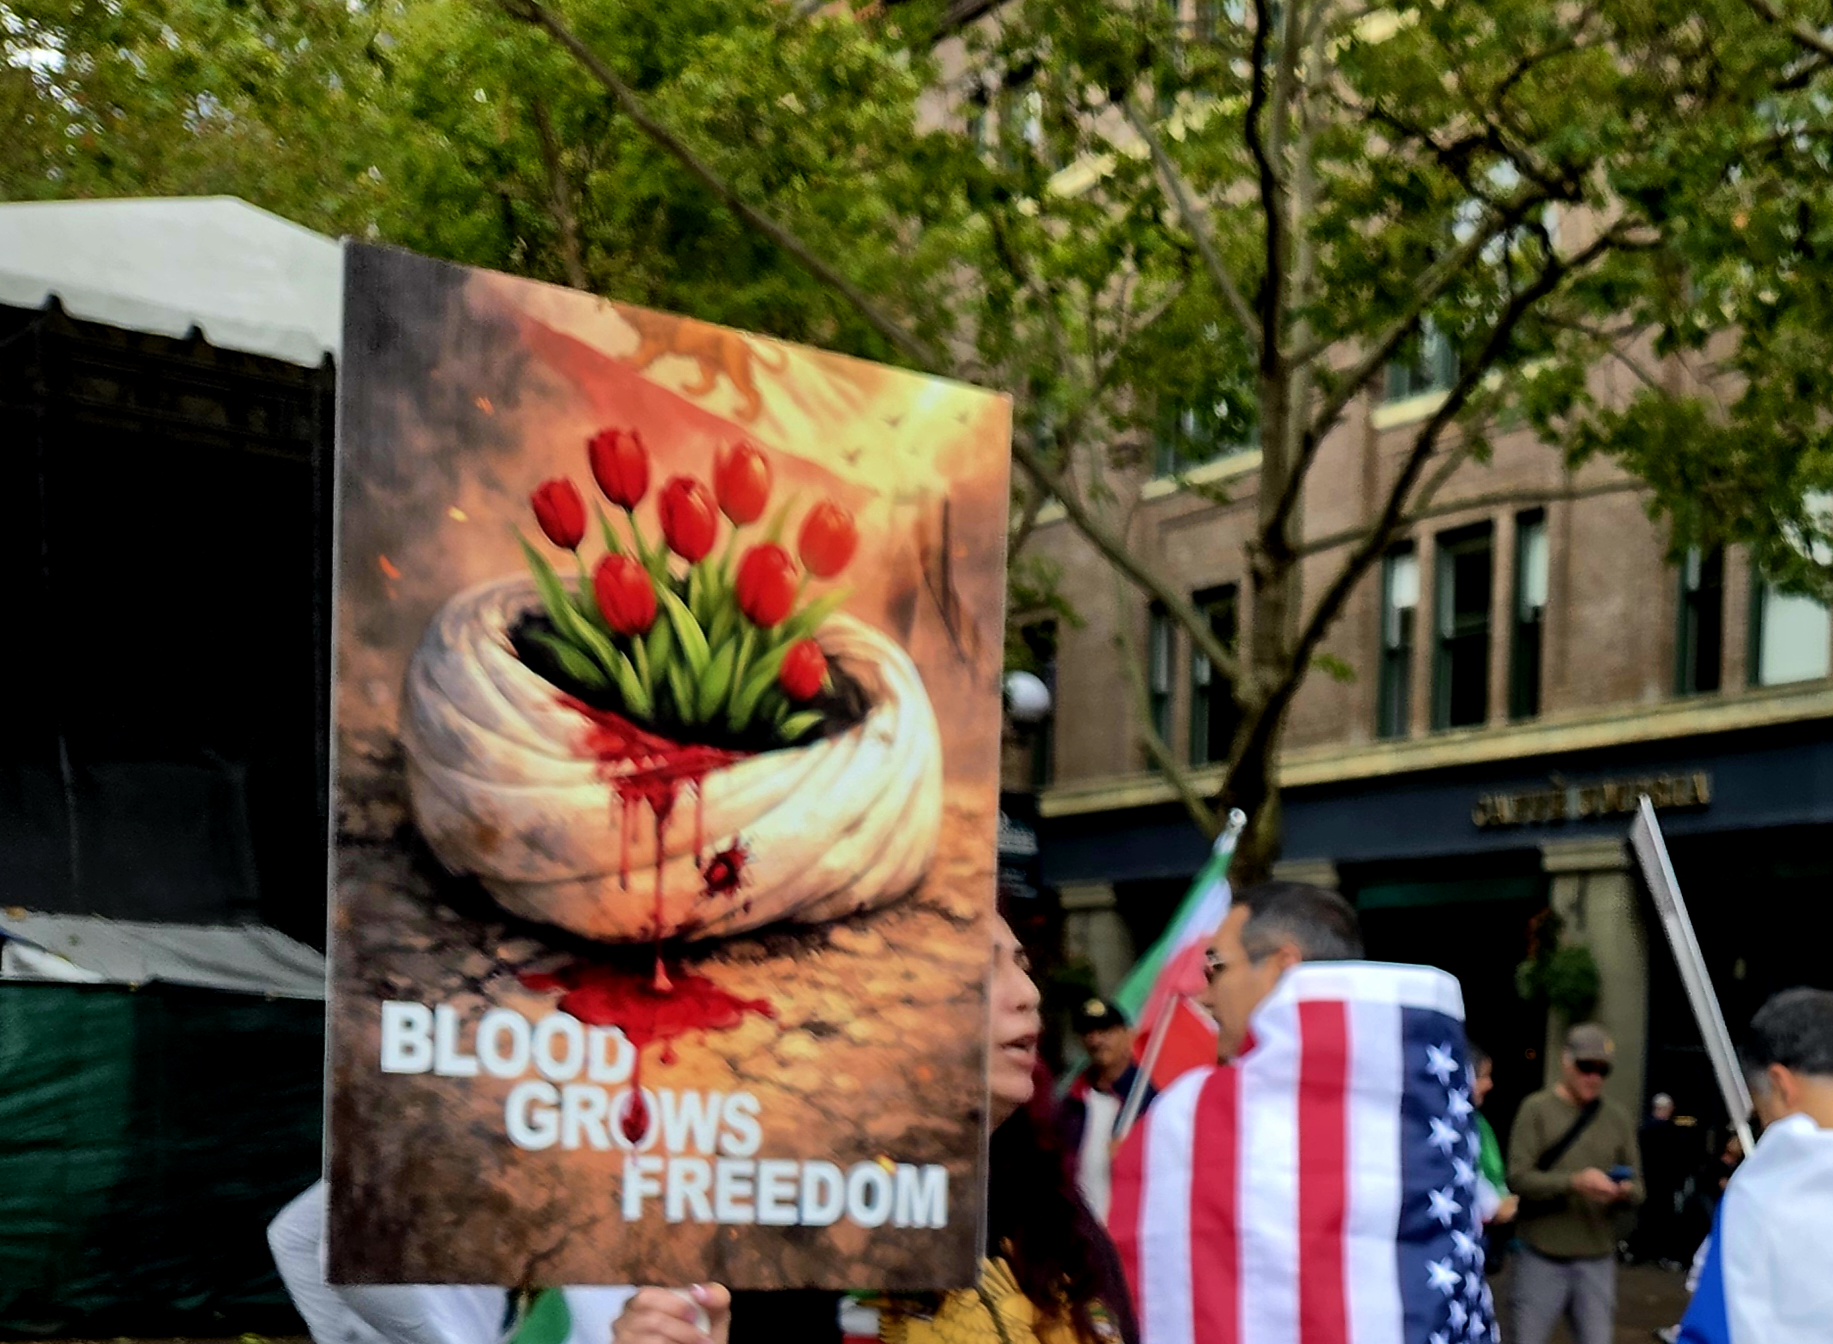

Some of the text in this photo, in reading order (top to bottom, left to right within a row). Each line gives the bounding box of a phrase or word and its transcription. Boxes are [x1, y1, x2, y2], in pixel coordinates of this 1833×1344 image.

[381, 1000, 635, 1083] BLOOD
[505, 1083, 762, 1156] GROWS
[621, 1157, 949, 1229] FREEDOM
